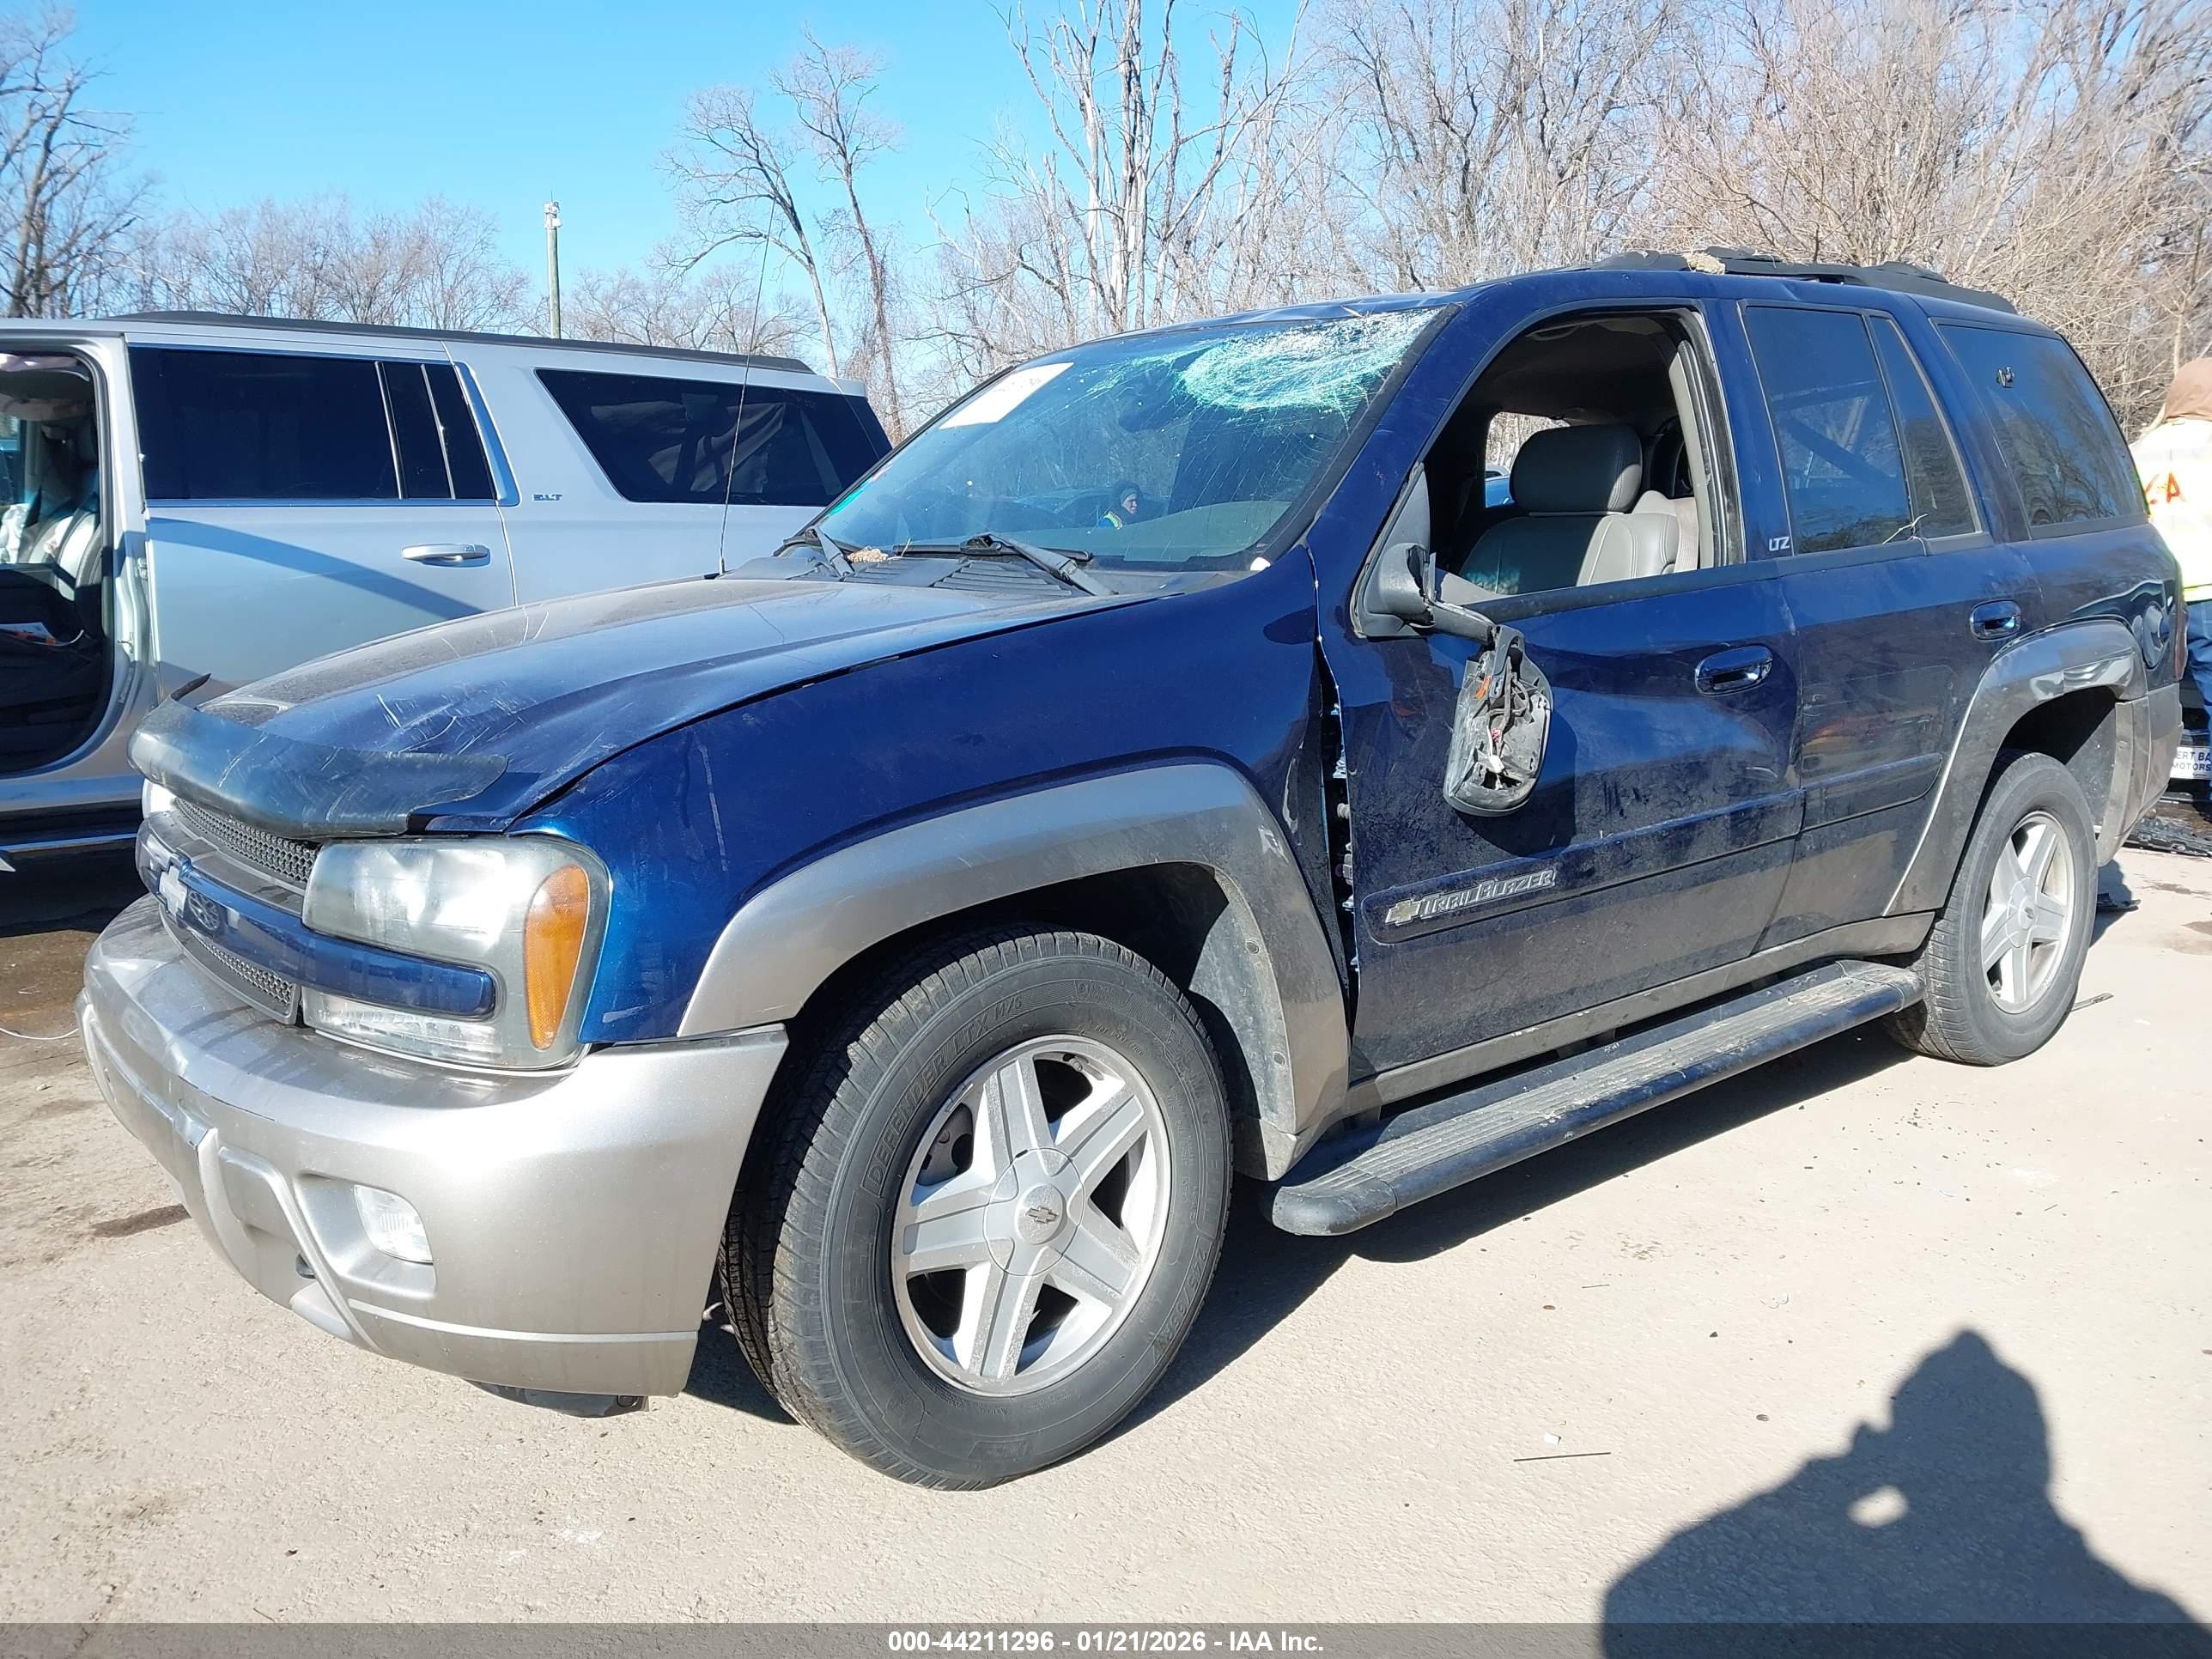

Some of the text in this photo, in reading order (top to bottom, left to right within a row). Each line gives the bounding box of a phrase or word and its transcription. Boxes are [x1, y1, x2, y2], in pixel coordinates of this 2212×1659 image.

[1769, 536, 1790, 551] LTZ
[866, 1054, 946, 1185] DEFENDER
[952, 1017, 990, 1054] LTX
